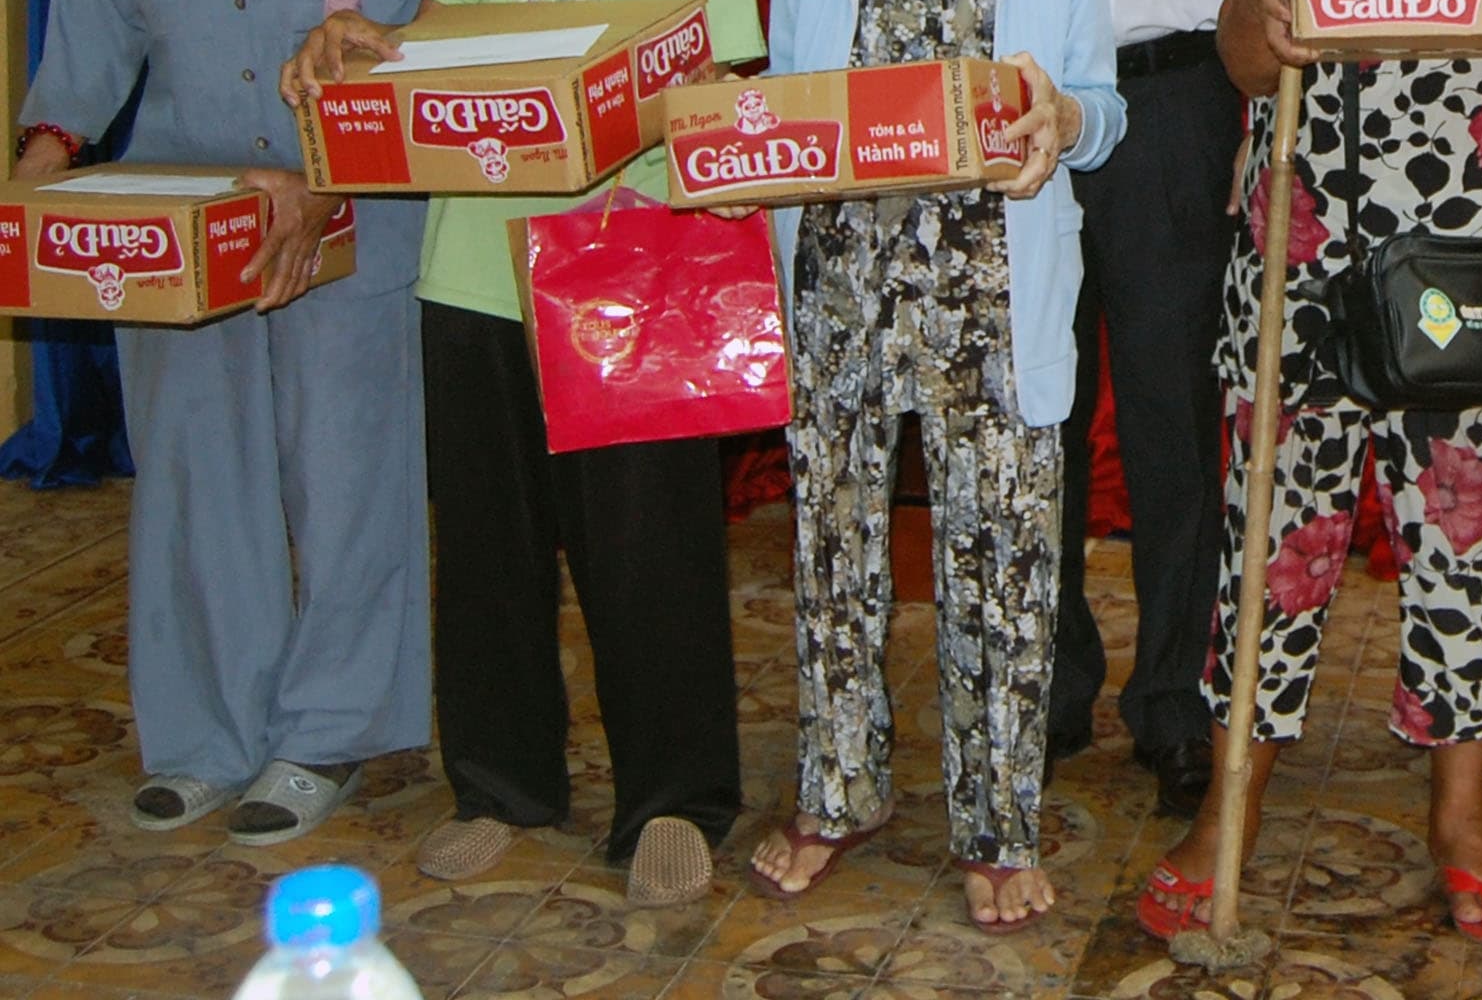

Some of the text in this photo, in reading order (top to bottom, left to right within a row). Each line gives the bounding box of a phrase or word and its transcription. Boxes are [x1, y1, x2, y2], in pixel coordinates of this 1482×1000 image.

[322, 98, 392, 117] Hành Phi
[953, 105, 969, 136] ngon
[857, 139, 940, 164] Hành Phi
[209, 212, 257, 240] Hành Phi
